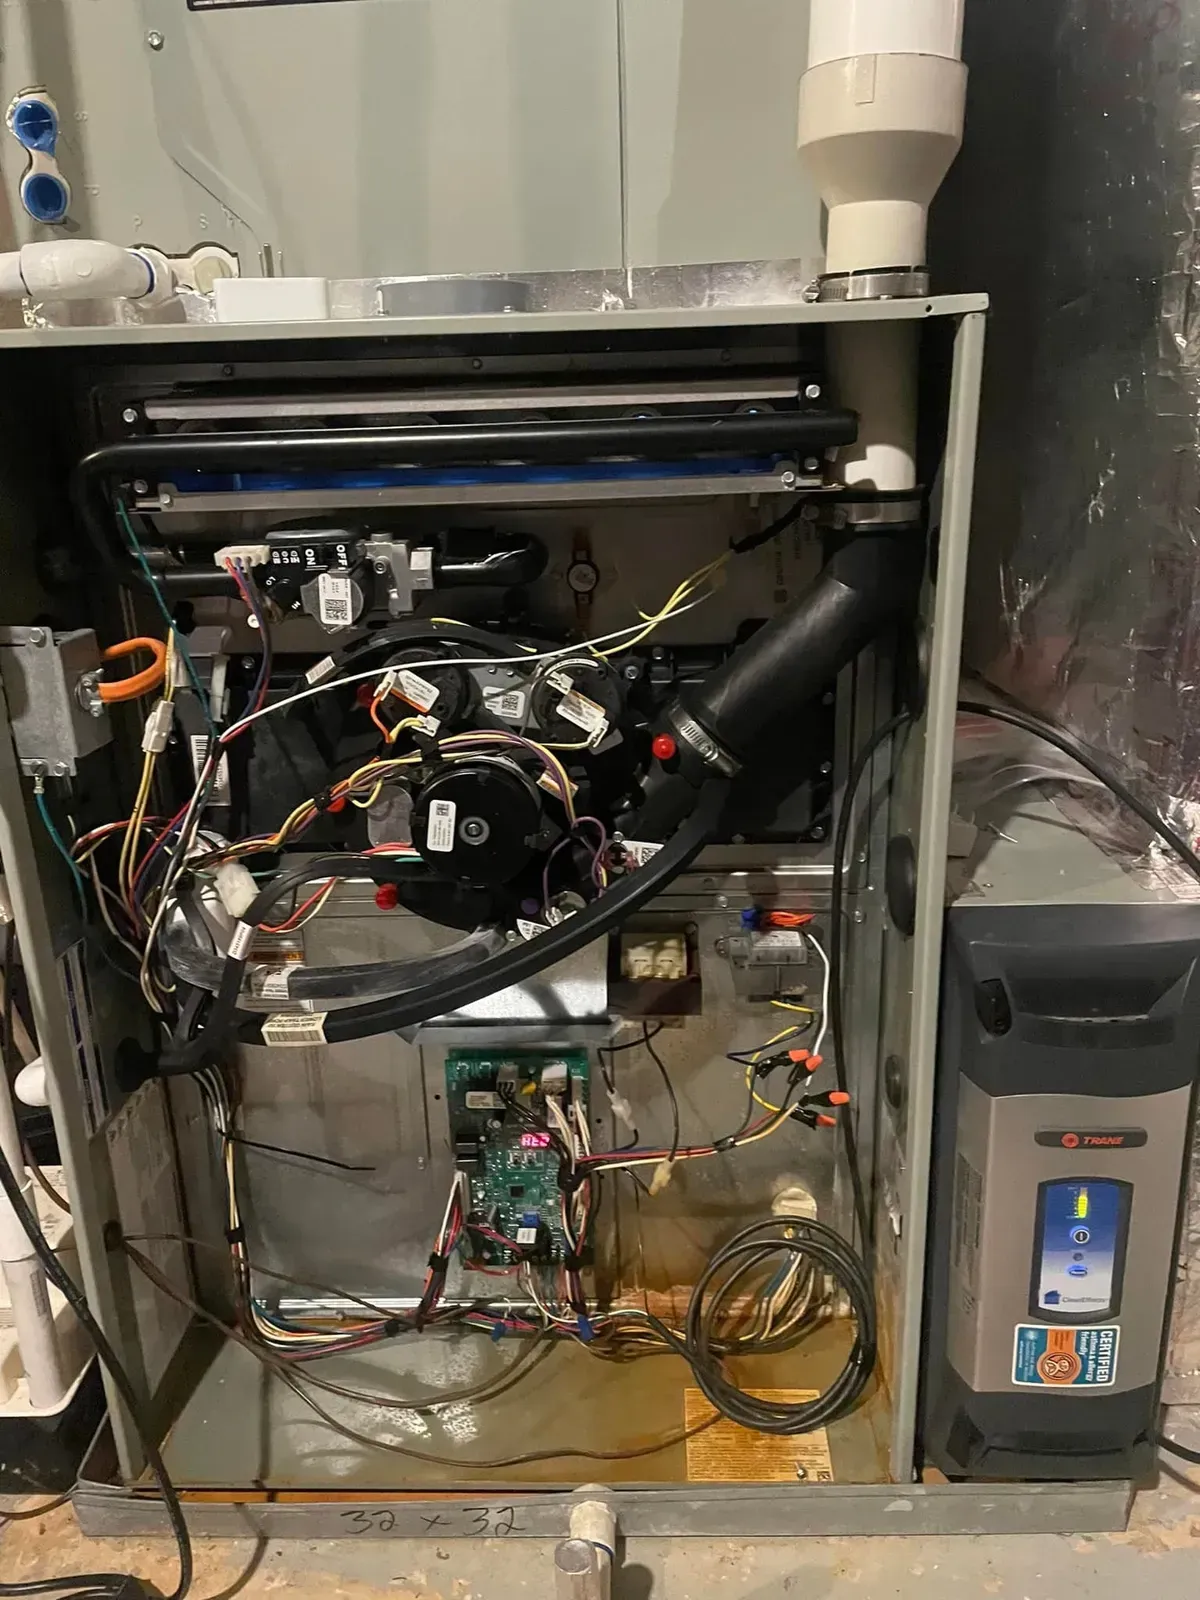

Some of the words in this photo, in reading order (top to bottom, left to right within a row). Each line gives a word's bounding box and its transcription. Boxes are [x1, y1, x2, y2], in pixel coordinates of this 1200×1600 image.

[305, 548, 317, 566] ON
[336, 544, 348, 566] OFF
[1083, 1136, 1124, 1145] TRANE
[1078, 1331, 1090, 1356] friendly
[1089, 1331, 1098, 1355] asthma
[1096, 1330, 1113, 1382] CERTIFIED
[1085, 1361, 1096, 1382] allergy
[340, 1509, 398, 1535] 32
[462, 1506, 526, 1537] 32
